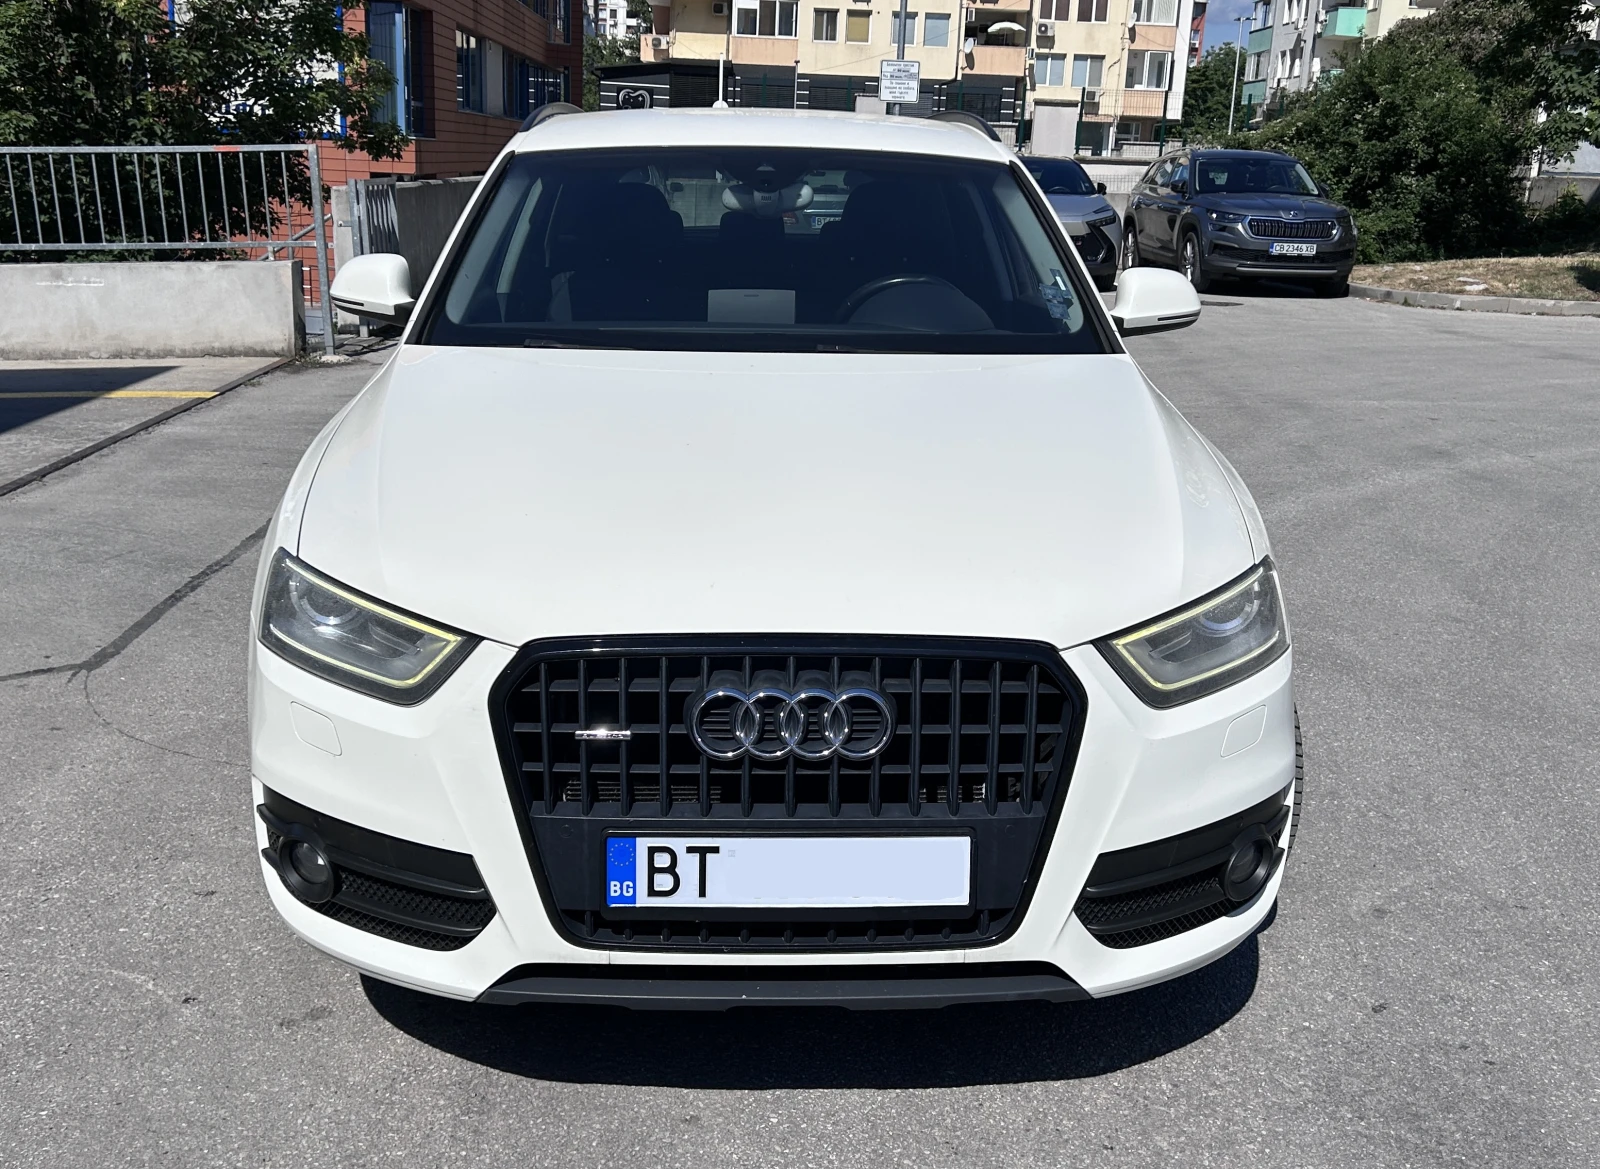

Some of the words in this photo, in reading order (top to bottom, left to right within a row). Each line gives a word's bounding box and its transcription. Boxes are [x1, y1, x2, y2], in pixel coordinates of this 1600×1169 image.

[1274, 244, 1285, 252] CB
[1285, 244, 1304, 253] 2346
[610, 880, 634, 897] BG
[647, 845, 720, 898] BT
